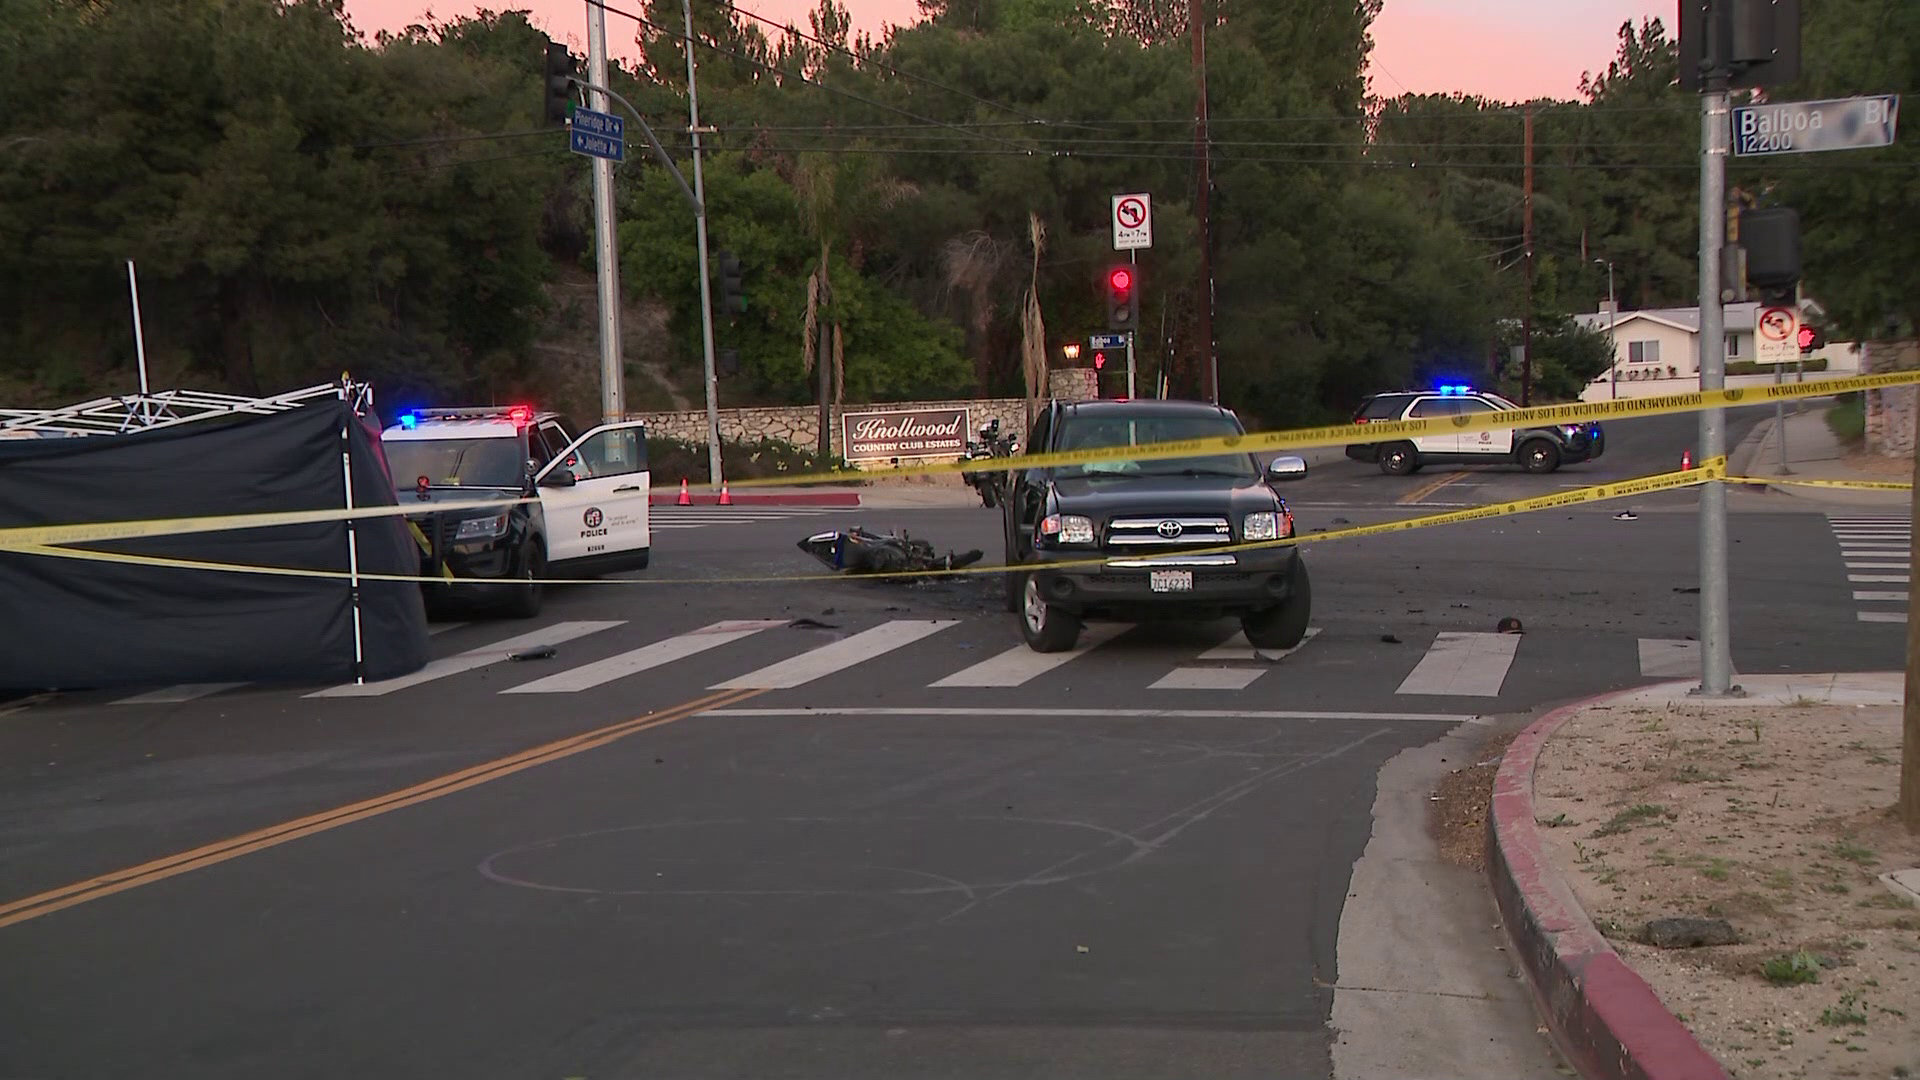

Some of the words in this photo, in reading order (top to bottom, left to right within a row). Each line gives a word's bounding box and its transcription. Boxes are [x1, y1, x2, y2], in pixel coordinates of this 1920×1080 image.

[575, 110, 605, 134] Pineridge
[605, 118, 613, 132] Dr
[1741, 109, 1823, 135] Balboa
[1864, 99, 1890, 125] Bl
[1741, 133, 1792, 153] 12200
[1767, 384, 1831, 397] DEPARTMENT
[1613, 402, 1625, 413] DE
[1628, 394, 1703, 411] DEPARTAMENTO
[1537, 409, 1556, 419] LOS
[1559, 408, 1570, 418] DE
[1573, 404, 1610, 416] POLICIA
[1493, 411, 1534, 423] ANGELES
[852, 415, 962, 440] Knollwood
[1364, 422, 1405, 436] ANGELES
[1409, 419, 1427, 430] LOS
[853, 442, 898, 452] COUNTRY
[900, 440, 924, 450] CLUB
[926, 439, 961, 449] ESTATES
[580, 528, 608, 538] POLICE
